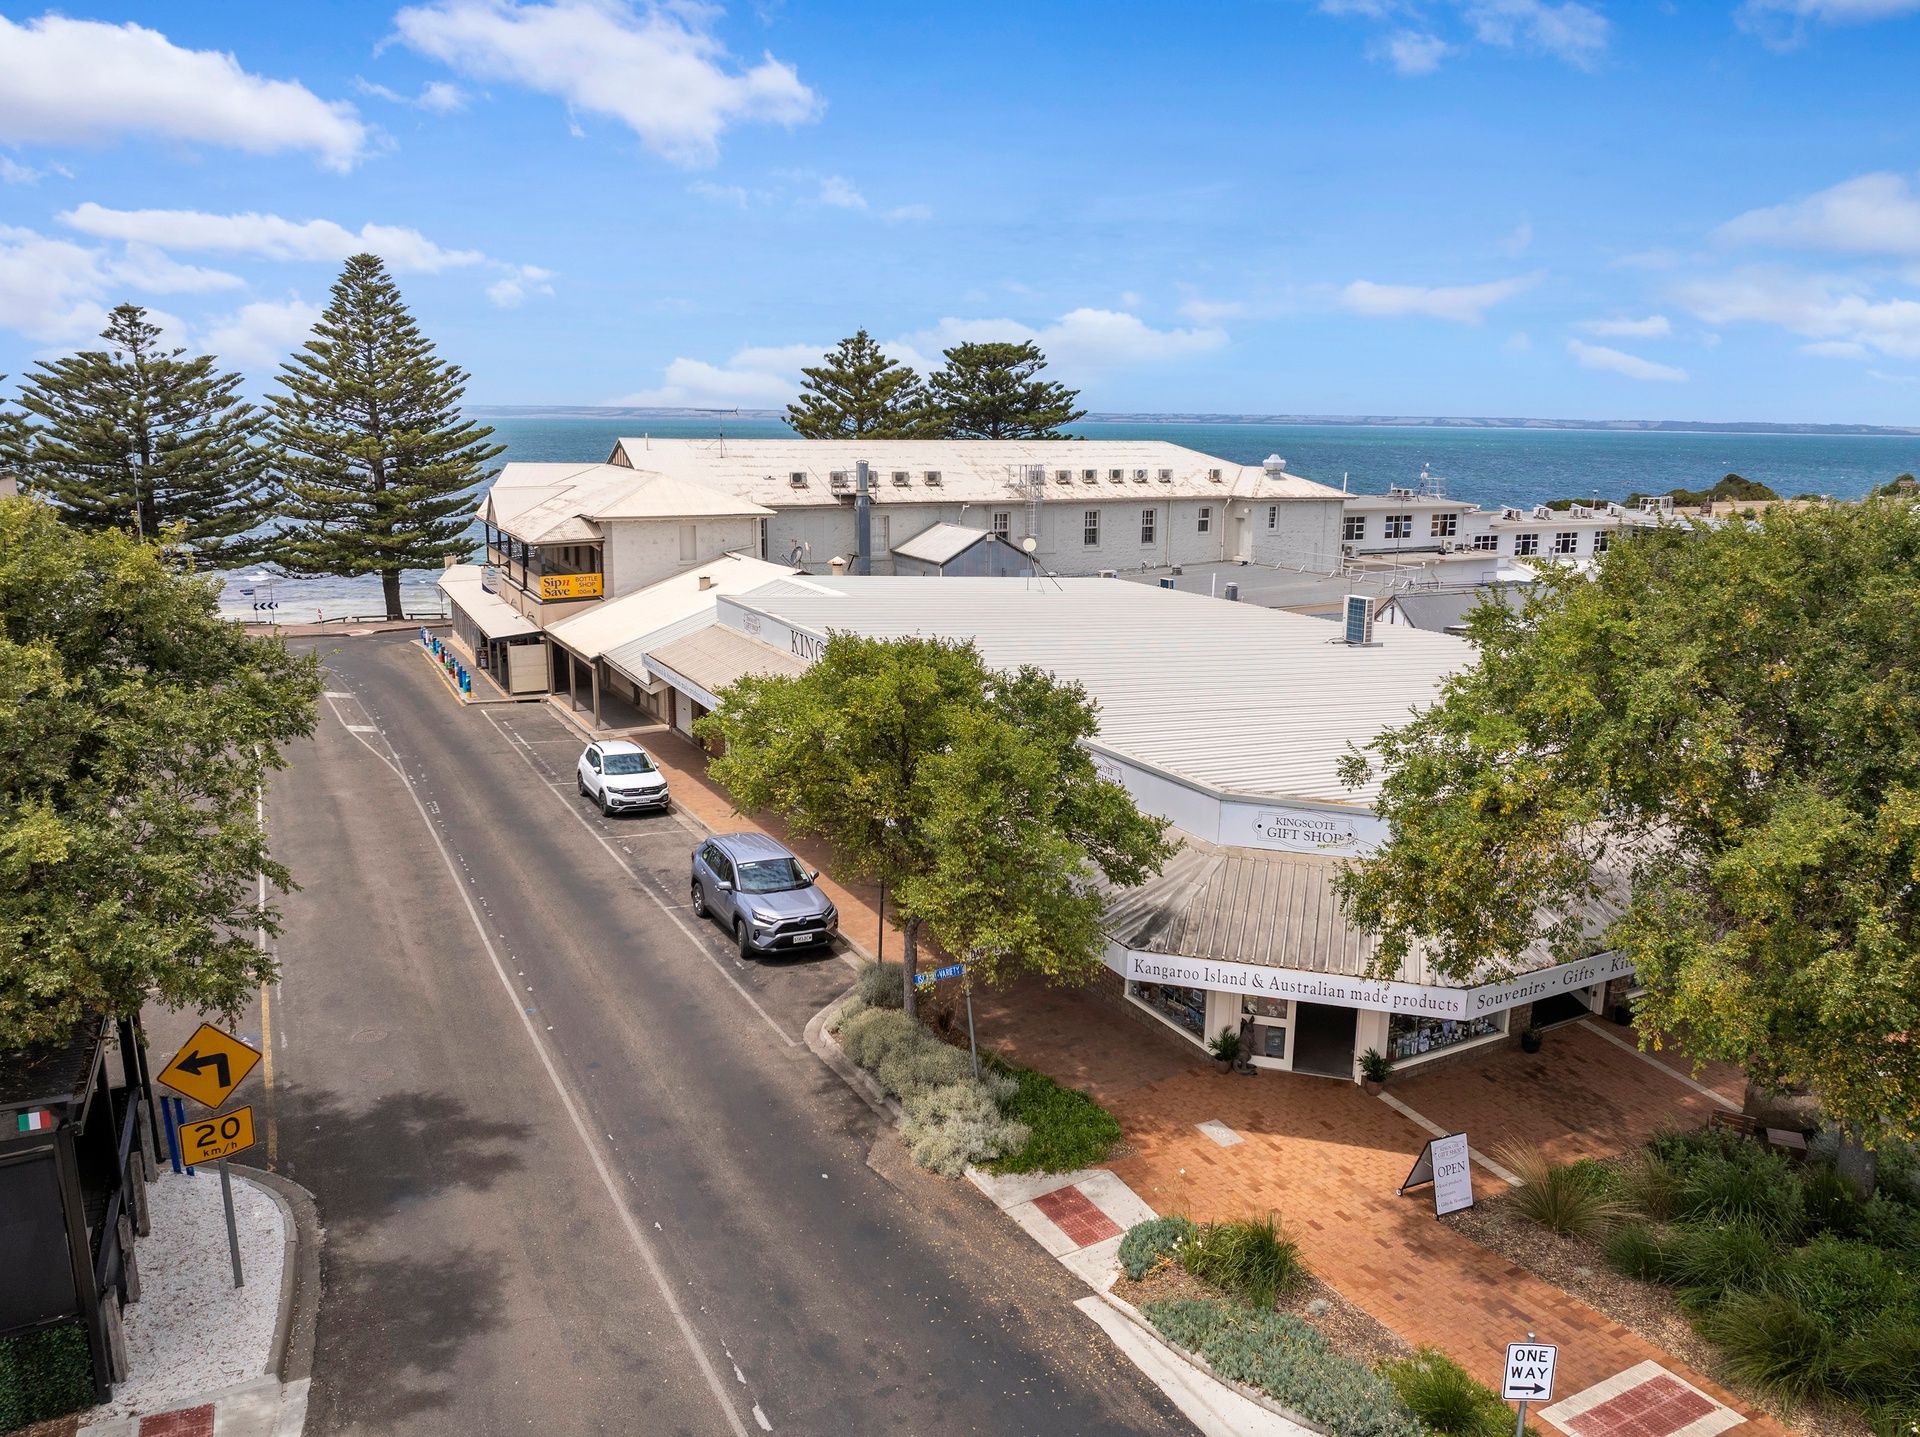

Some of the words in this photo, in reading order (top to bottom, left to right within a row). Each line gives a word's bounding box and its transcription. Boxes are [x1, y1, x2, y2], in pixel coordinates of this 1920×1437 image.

[545, 588, 570, 597] Save
[1276, 817, 1336, 830] KINGSCOTE
[1267, 827, 1299, 840] GIFT
[1304, 831, 1343, 844] SHOP
[1134, 958, 1199, 980] Kangaroo
[1204, 967, 1247, 986] Island
[1252, 973, 1264, 988] &
[1269, 976, 1345, 999] Australian
[1350, 988, 1388, 1004] made
[1393, 993, 1459, 1012] products
[1477, 980, 1546, 1009] Souvenirs
[1562, 965, 1596, 986] Gifts
[195, 1117, 240, 1148] 20
[203, 1142, 237, 1157] km/h
[1438, 1161, 1465, 1177] OPEN
[1515, 1349, 1548, 1362] ONE
[1511, 1366, 1548, 1379] WAY
